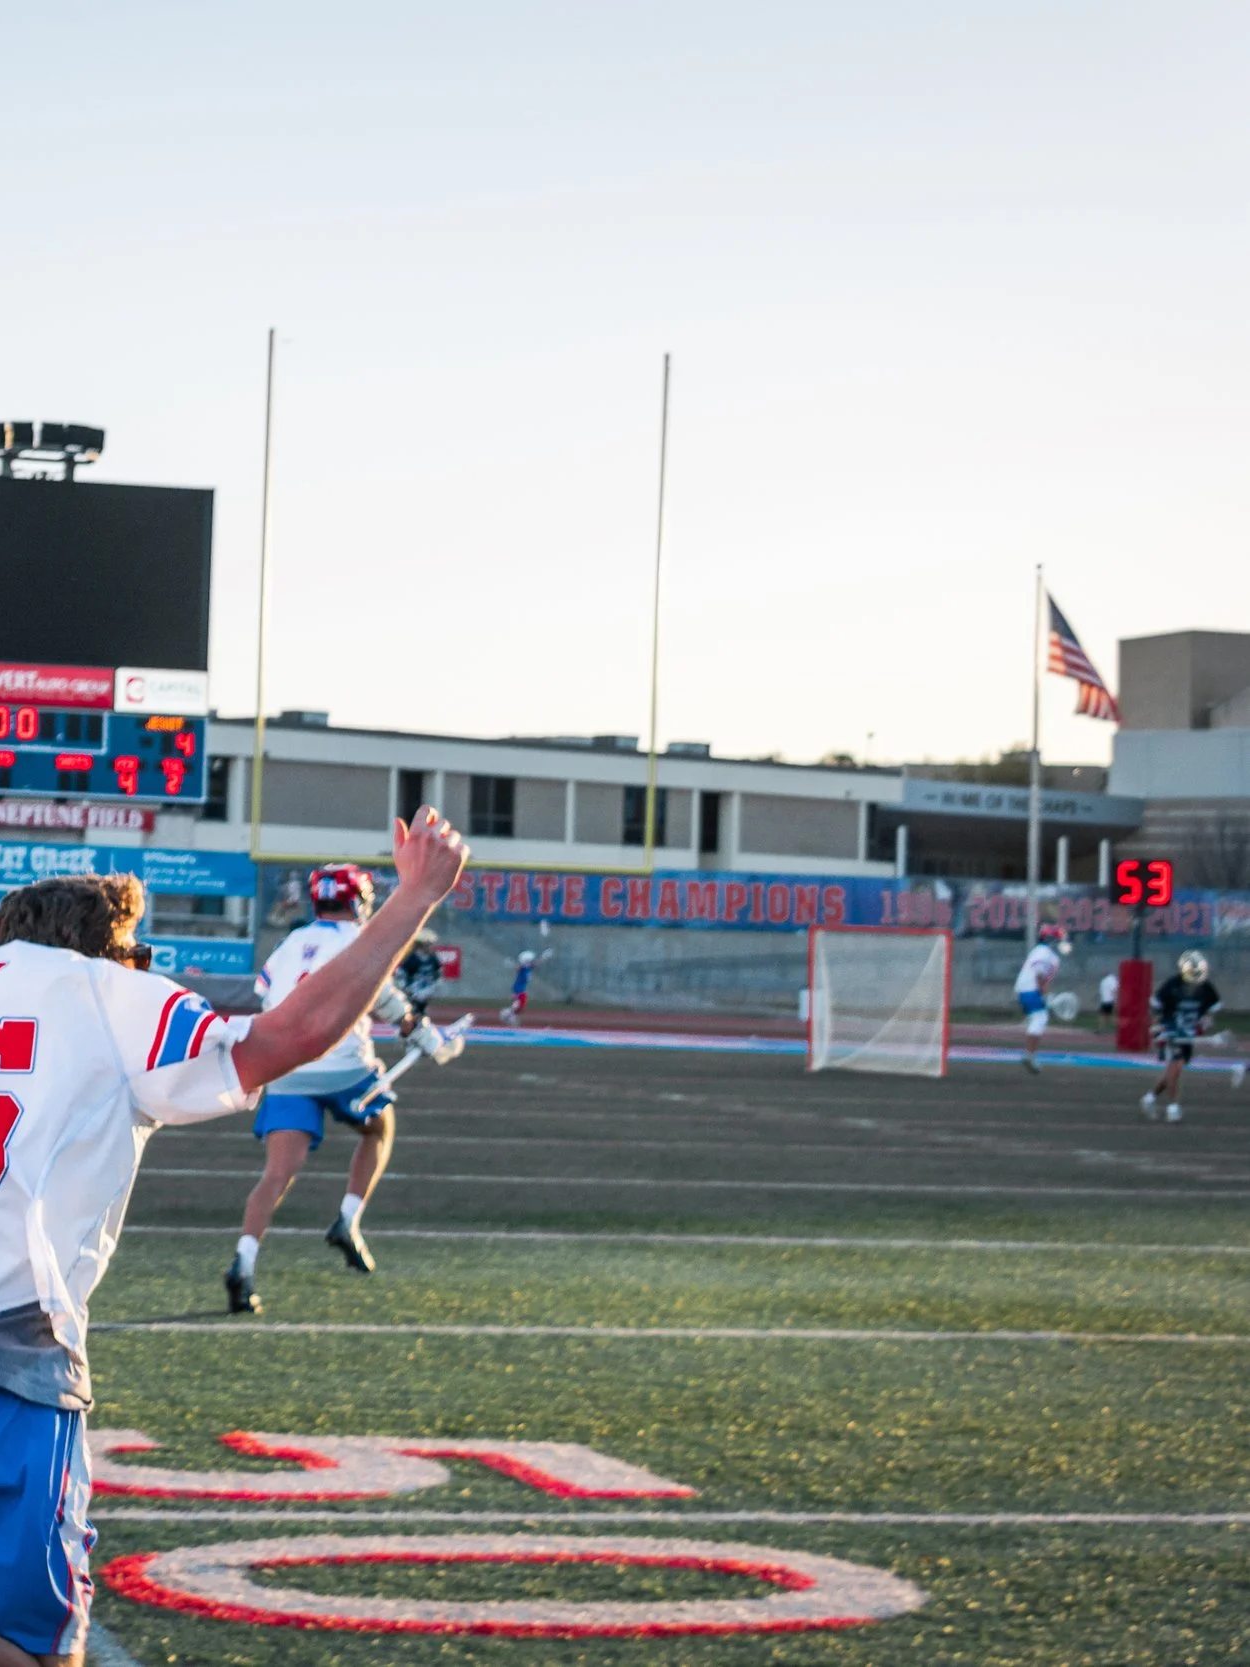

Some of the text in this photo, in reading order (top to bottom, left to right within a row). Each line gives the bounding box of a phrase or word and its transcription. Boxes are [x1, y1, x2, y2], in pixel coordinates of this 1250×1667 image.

[175, 732, 195, 757] 4
[118, 772, 137, 797] 4
[88, 806, 143, 829] FIELD
[31, 846, 97, 872] CREEK
[1116, 859, 1173, 907] 53
[452, 871, 586, 916] STATE
[600, 876, 846, 924] CHAMPIONS
[970, 895, 1040, 929] 201
[180, 950, 245, 964] CAPITAL
